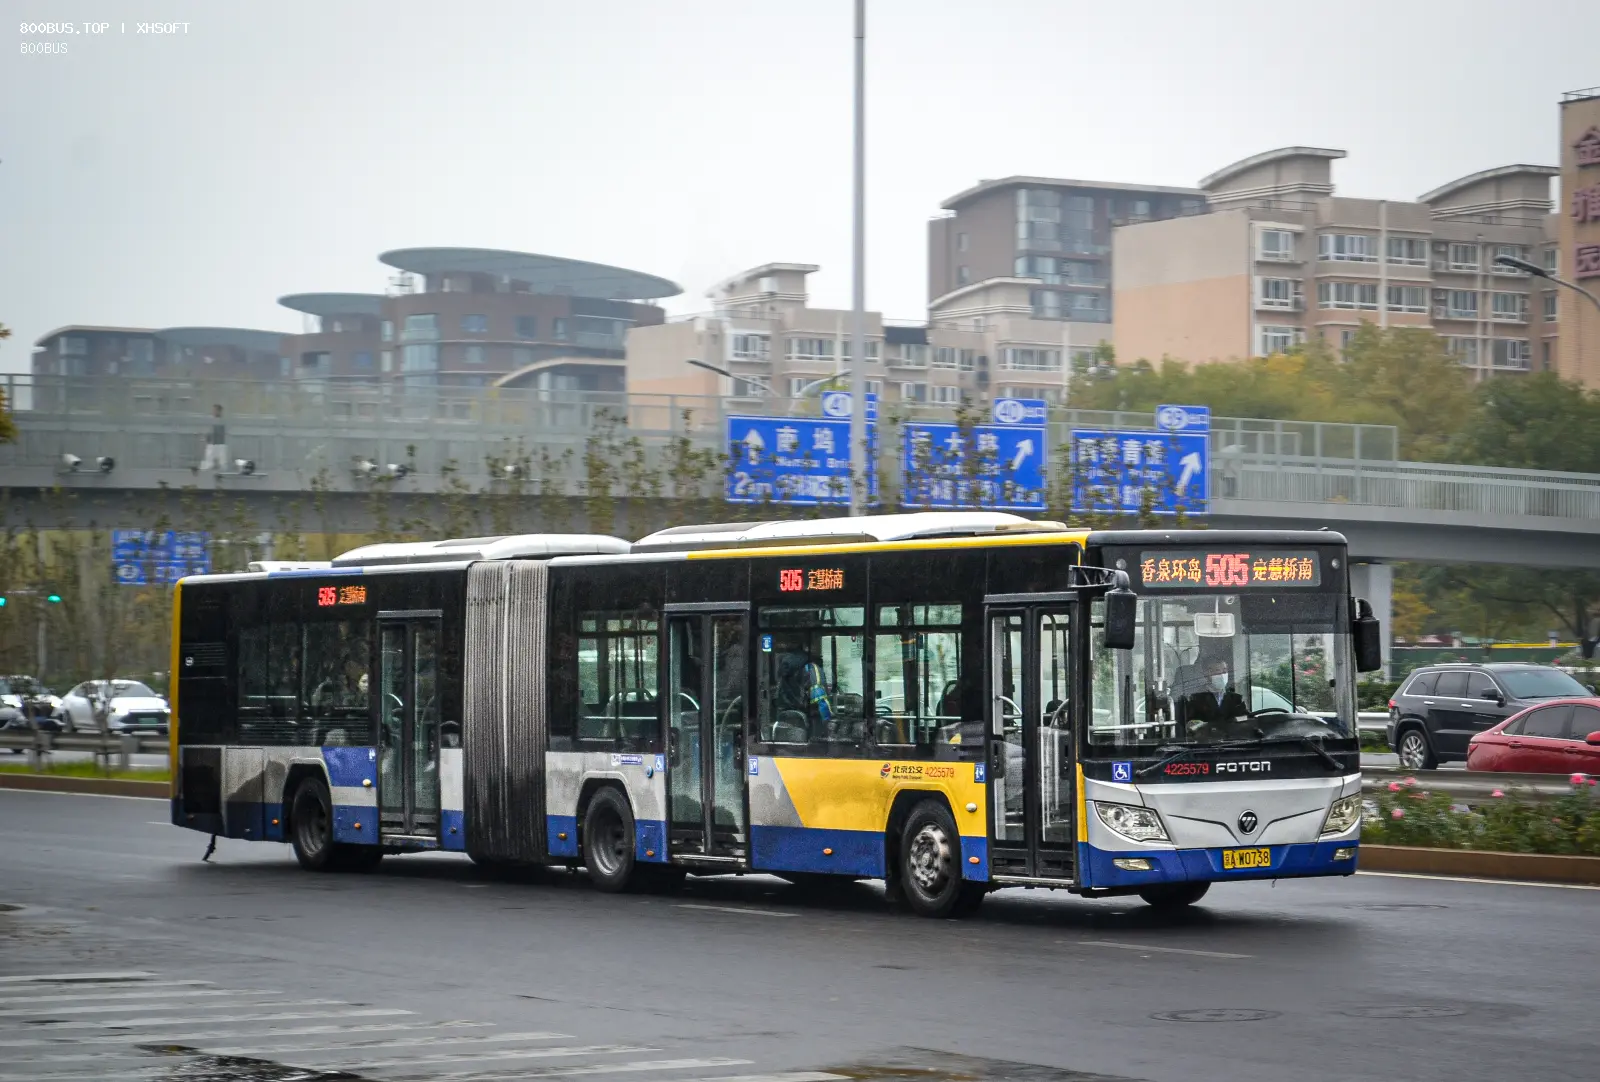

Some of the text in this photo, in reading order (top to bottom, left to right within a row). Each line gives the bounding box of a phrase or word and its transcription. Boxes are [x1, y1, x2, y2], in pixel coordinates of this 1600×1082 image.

[1140, 553, 1312, 587] 香泉环岛 505 定慧桥南
[780, 569, 803, 591] 505
[893, 765, 955, 778] 北京公交 4225579
[1164, 761, 1271, 775] 4225579 FOTON
